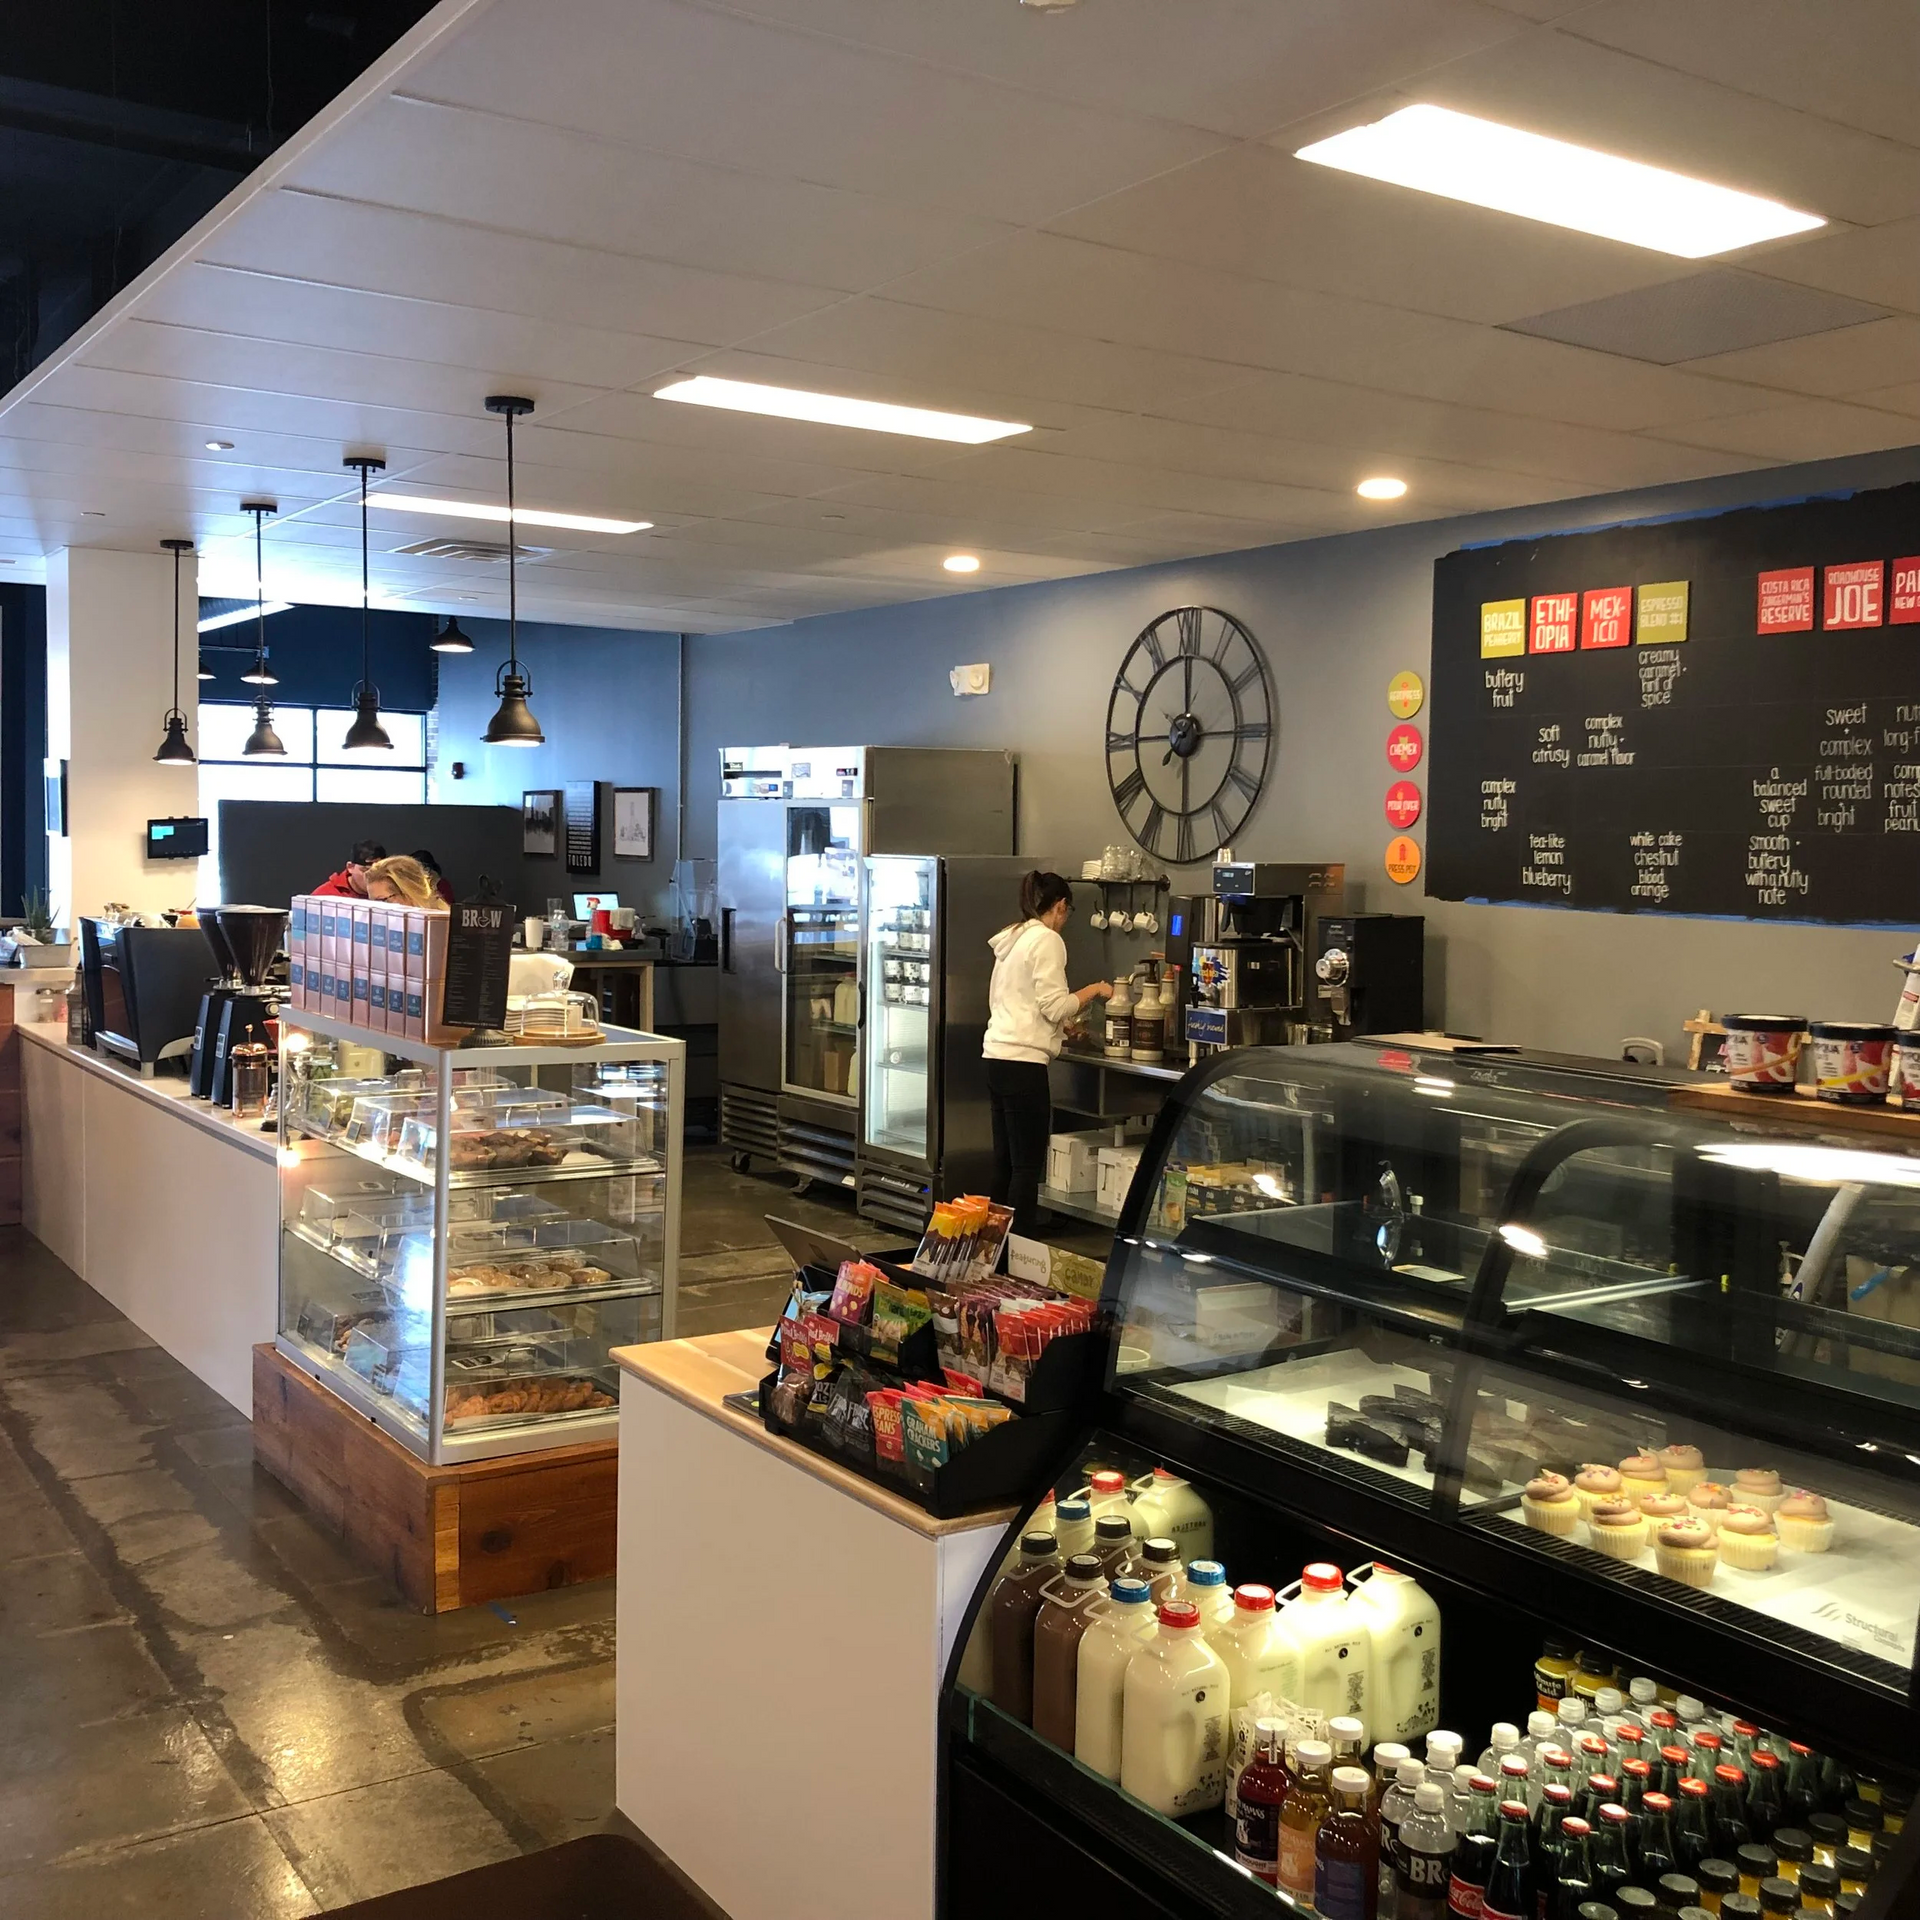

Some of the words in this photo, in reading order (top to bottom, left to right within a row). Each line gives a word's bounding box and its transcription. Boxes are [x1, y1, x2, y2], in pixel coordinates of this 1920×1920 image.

[1761, 581, 1788, 594] COSTA
[1791, 578, 1810, 591] RICA
[1828, 568, 1879, 585] ROADHOUSE
[1895, 569, 1920, 594] PA
[1536, 598, 1575, 624] ETHI-
[1590, 596, 1625, 619] MEX-
[1641, 596, 1683, 611] ESPRESSO
[1826, 583, 1879, 625] JOE
[1894, 596, 1915, 609] NEW
[1484, 611, 1522, 632] BRAZIL
[1761, 604, 1810, 624] RESERVE
[1536, 625, 1569, 649] OPIA
[1593, 621, 1618, 642] ICO
[1638, 649, 1680, 666] creamy
[1638, 662, 1680, 679] caramel
[1485, 669, 1524, 692] buttery
[1492, 689, 1514, 708] fruit
[1641, 690, 1671, 709] spice
[1585, 713, 1623, 734] complex
[1826, 702, 1868, 726] sweet
[1538, 725, 1560, 743] soft
[1588, 731, 1617, 749] nutty
[1820, 736, 1873, 759] complex
[1532, 748, 1570, 768] citrusy
[1770, 766, 1779, 779] a
[1481, 778, 1516, 796] complex
[1753, 779, 1807, 797] balanced
[1822, 780, 1872, 799] rounded
[1483, 796, 1508, 815] nutty
[1759, 796, 1796, 813] sweet
[1888, 800, 1918, 818] fruit
[1481, 812, 1508, 832] bright
[1767, 814, 1791, 831] cup
[1817, 805, 1856, 832] bright
[1529, 833, 1565, 849] tea-like
[1658, 831, 1683, 846] cake
[1749, 834, 1790, 851] smooth
[568, 855, 592, 867] TOLEDO
[1534, 850, 1564, 865] lemon
[1634, 849, 1679, 866] chestnut
[1748, 852, 1791, 874] buttery
[1388, 864, 1405, 873] PRESS
[1405, 865, 1416, 875] POT
[1639, 868, 1665, 885] blood
[1522, 867, 1572, 895] blueberry
[1745, 871, 1768, 886] with
[1778, 870, 1809, 895] nutty
[1631, 884, 1670, 904] orange
[1758, 888, 1786, 905] note
[1010, 1252, 1046, 1274] featuring
[906, 1416, 937, 1440] GRAHAM
[907, 1429, 941, 1452] CRACKERS
[1845, 1613, 1898, 1641] Structural
